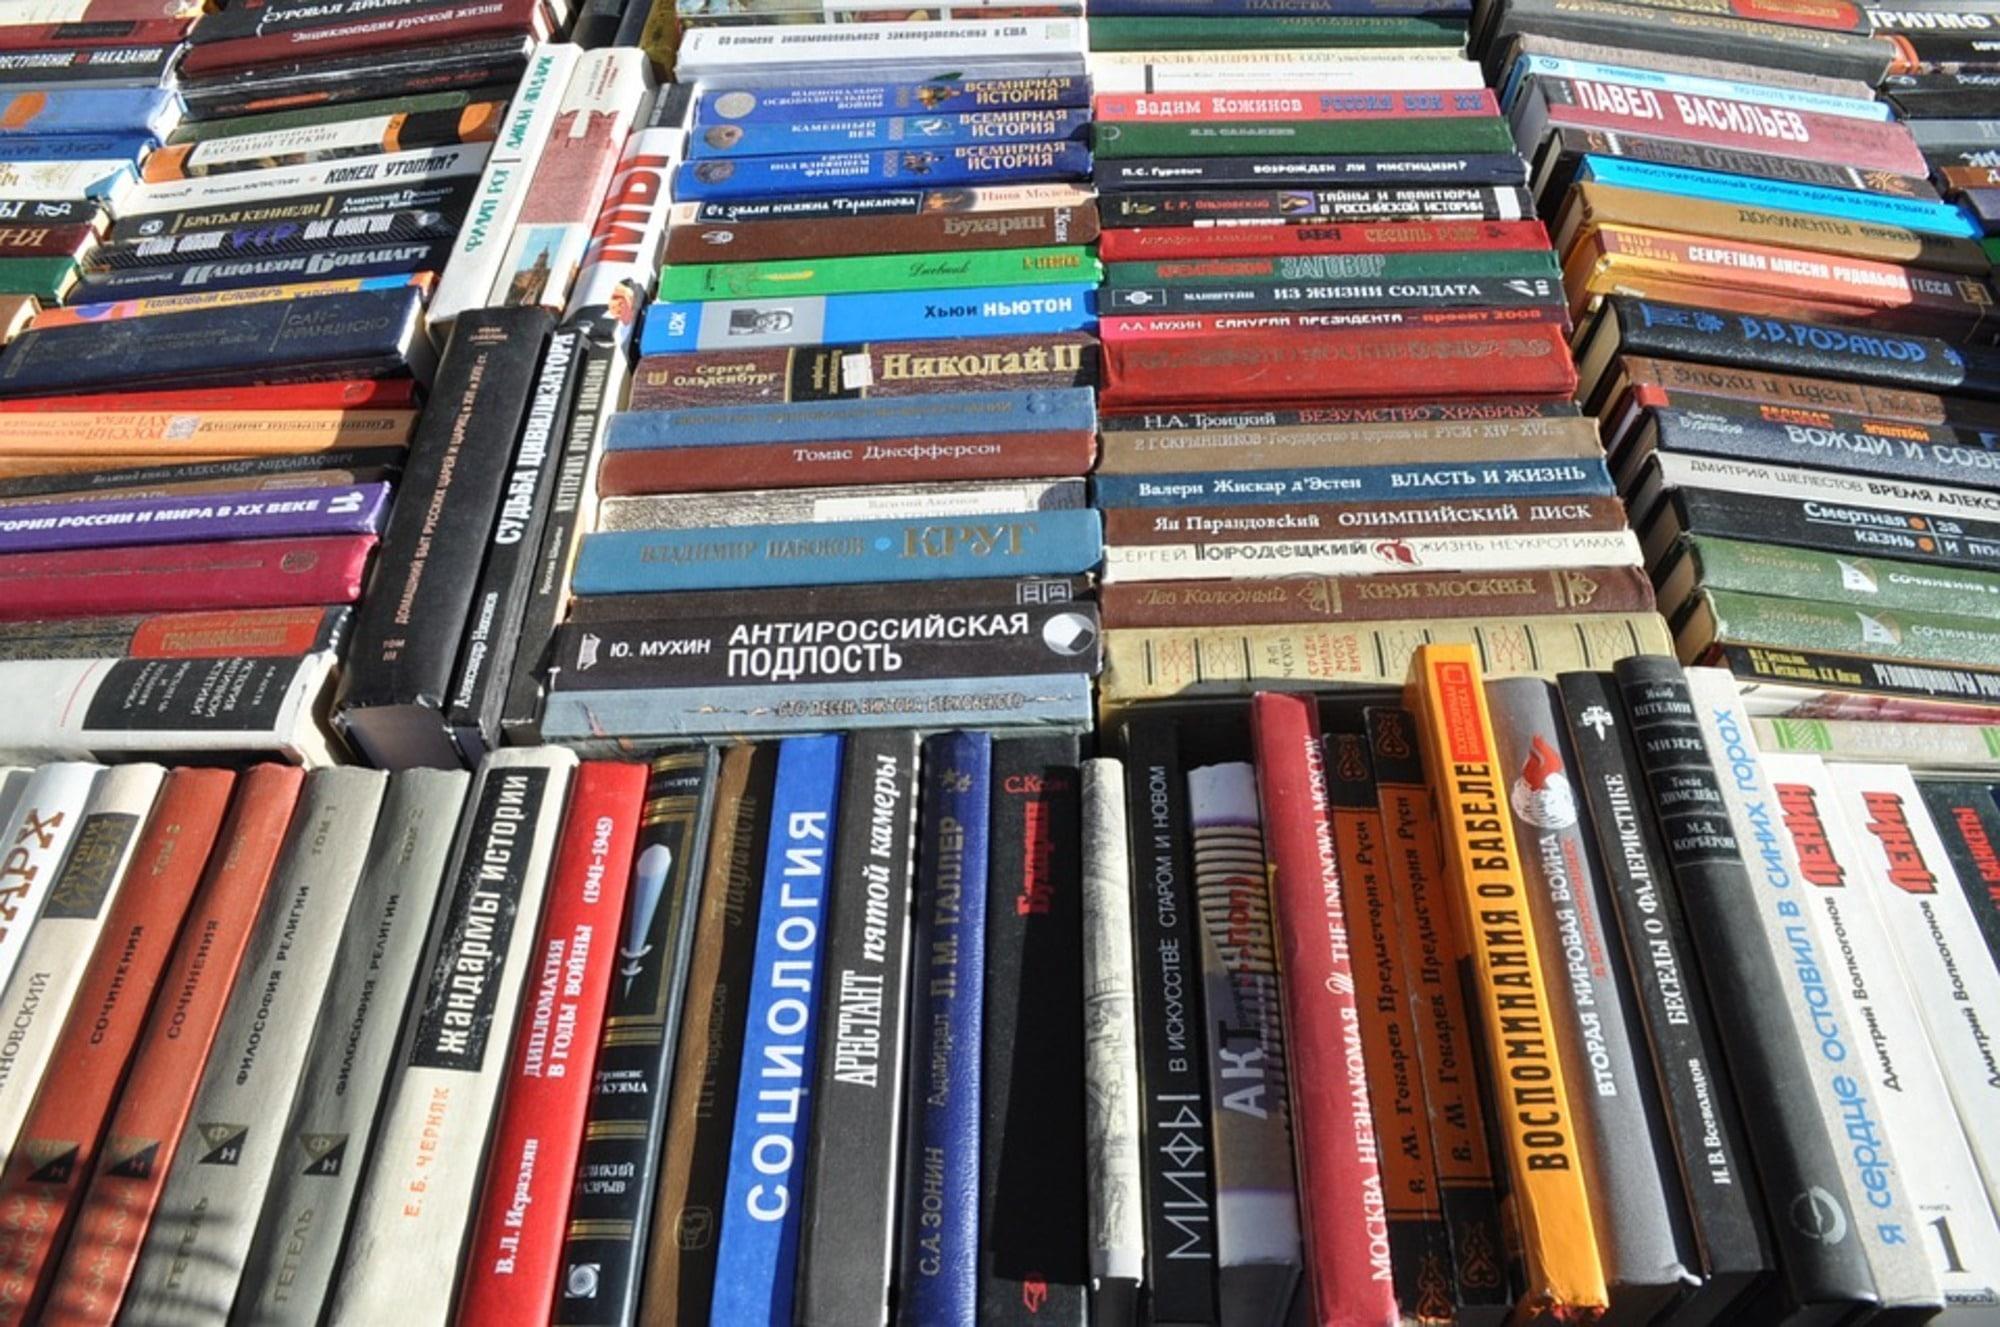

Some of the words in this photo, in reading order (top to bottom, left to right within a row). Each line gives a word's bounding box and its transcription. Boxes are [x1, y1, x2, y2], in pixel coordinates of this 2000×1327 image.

[1002, 27, 1028, 39] США
[963, 77, 1071, 94] ВСЕМИРНАЯ
[975, 89, 1060, 105] ИСТОРИЯ
[1136, 97, 1201, 116] Вадим
[1211, 95, 1304, 114] Кожинов
[959, 110, 1068, 126] ВСЕМИРНАЯ
[971, 121, 1056, 138] ИСТОРИЯ
[1574, 79, 1664, 121] ПАВЕЛ
[1673, 93, 1810, 143] ВАСИЛЬЕВ
[954, 141, 1067, 158] ВСЕМИРНАЯ
[967, 152, 1054, 171] ИСТОРИЯ
[1345, 162, 1367, 173] ЛИ
[1702, 150, 1845, 185] ОТЕЧЕСТВА
[323, 163, 376, 185] КОНЕЦ
[1317, 189, 1370, 203] ТАЙНЫ
[1396, 187, 1482, 201] АВАНТЮРЫ
[183, 210, 241, 228] БРАТЬЯ
[242, 202, 321, 222] КЕННЕДИ
[944, 213, 1047, 237] Бухарин
[1335, 200, 1420, 215] РОССИЙСКОЙ
[1423, 197, 1484, 213] ИСТОРИИ
[1738, 209, 1852, 236] ДОКУМЕНТЫ
[180, 256, 305, 285] НАПОЛЕОН
[304, 245, 431, 275] БОНАПАРТ
[1280, 253, 1385, 279] ЗАГОВОР
[1688, 246, 1766, 271] СЕКРЕТНАЯ
[1770, 255, 1831, 279] МИССИЯ
[1910, 278, 1953, 297] ГЕССА
[924, 302, 978, 319] Хьюи
[1273, 286, 1302, 300] ИЗ
[1306, 285, 1384, 300] ЖИЗНИ
[1388, 282, 1482, 298] СОЛДАТА
[1150, 319, 1203, 331] МУХИН
[673, 370, 778, 387] Ольденбург
[696, 362, 757, 373] Сергей
[882, 347, 1047, 380] Николай
[1675, 364, 1753, 393] Эпохи
[1761, 379, 1779, 394] и
[1790, 383, 1860, 407] идеи
[1144, 413, 1189, 429] Н.А.
[1192, 410, 1277, 429] Троицкий
[1299, 406, 1430, 425] БЕЗУМСТВО
[1440, 404, 1545, 420] ХРАБРЫХ
[494, 468, 538, 546] СУДЬБА
[520, 332, 576, 469] ЦИВИЛИЗАТОРА
[793, 446, 853, 462] Томас
[862, 443, 1002, 464] Джефферсон
[1785, 424, 1893, 459] ВОЖДИ
[1903, 440, 1924, 461] И
[1137, 481, 1204, 499] Валери
[1213, 478, 1287, 496] Жискар
[1391, 470, 1477, 488] ВЛАСТЬ
[1483, 470, 1499, 484] И
[1504, 466, 1587, 484] ЖИЗНЬ
[1690, 461, 1771, 481] ДМИТРИЙ
[1774, 470, 1863, 492] ШЕЛЕСТОВ
[1868, 482, 1933, 503] ВРЕМЯ
[59, 511, 132, 529] РОССИИ
[135, 511, 151, 523] И
[154, 505, 214, 522] МИРА
[217, 504, 231, 517] В
[265, 498, 320, 514] ВЕКЕ
[1153, 515, 1182, 531] Ян
[1186, 511, 1321, 531] Парандовский
[1338, 503, 1520, 527] ОЛИМПИЙСКИЙ
[1529, 503, 1592, 523] ДИСК
[1803, 502, 1908, 529] Смертная
[1938, 519, 1964, 535] за
[640, 541, 757, 564] ВЛАДИМИР
[765, 538, 864, 560] НАБОКОВ
[899, 520, 1038, 559] КРУГ
[1418, 538, 1486, 554] ЖИЗНЬ
[1489, 534, 1627, 552] НЕУКРОТИМАЯ
[1854, 530, 1915, 551] казнь
[1195, 584, 1287, 606] Колодный
[1358, 581, 1419, 601] КРАЯ
[1421, 575, 1538, 599] МОСКВЫ
[610, 641, 635, 657] Ю.
[640, 639, 712, 657] МУХИН
[728, 611, 1029, 646] АНТИРОССИЙСКАЯ
[727, 643, 904, 681] ПОДЛОСТЬ
[1713, 709, 1757, 792] горах
[869, 754, 903, 858] камеры
[1149, 765, 1169, 829] НОВОМ
[1396, 796, 1415, 841] Руси
[1454, 763, 1510, 872] БАБЕЛЕ
[1154, 836, 1172, 850] И
[1355, 820, 1376, 866] Руси
[1604, 773, 1659, 916] ФАЛЕРИСТИКЕ
[1746, 801, 1792, 889] синих
[1773, 783, 1847, 888] ЛЕНИН
[1861, 790, 1939, 895] ЛЕНИН
[935, 815, 965, 926] ГАЛЛЕР
[1315, 820, 1343, 918] UNKNOWN
[1539, 833, 1571, 901] ВОЙНА
[862, 865, 891, 963] пятой
[1155, 855, 1178, 929] СТАРОМ
[1477, 883, 1516, 901] О
[1328, 925, 1350, 963] THE
[1643, 918, 1664, 933] О
[564, 923, 594, 997] ВОЙНЫ
[1556, 906, 1595, 1006] МИРОВАЯ
[1824, 895, 1868, 1004] Волкогонов
[1919, 900, 1970, 1004] Волкогонов
[91, 924, 145, 1045] СОЧИНЕНИЯ
[166, 919, 220, 1041] СОЧИНЕНИЯ
[235, 968, 283, 1088] ФИЛОСОФИЯ
[278, 885, 310, 963] РЕЛИГИИ
[335, 977, 377, 1098] ФИЛОСОФИЯ
[371, 893, 400, 974] РЕЛИГИИ
[1158, 937, 1187, 1051] ИСКУССТВЕ
[1650, 938, 1690, 1026] БЕСЕДЫ
[1785, 925, 1847, 1063] оставил
[523, 938, 567, 1079] ДИПЛОМАТИЯ
[746, 810, 828, 1222] СОЦИОЛОГИЯ
[833, 968, 885, 1089] АРЕСТАНТ
[552, 1003, 578, 1062] ГОДЫ
[1480, 908, 1570, 1172] ВОСПОМИНАНИЯ
[1580, 1011, 1618, 1097] ВТОРАЯ
[1860, 1006, 1903, 1092] Дмитрий
[547, 1064, 566, 1078] В
[928, 1012, 954, 1108] Адмирал
[1168, 1056, 1189, 1073] В
[1340, 1006, 1379, 1165] НЕЗНАКОМАЯ
[416, 1087, 450, 1168] ЧЕРНЯК
[1831, 1074, 1893, 1210] сердце
[505, 1138, 540, 1228] Исраэлян
[922, 1147, 946, 1229] ЗОНИН
[1157, 1094, 1213, 1260] МИФЫ
[1362, 1173, 1393, 1282] МОСКВА
[1929, 1215, 1970, 1274] 1
[273, 1208, 315, 1303] ГЕГЕЛЬ
